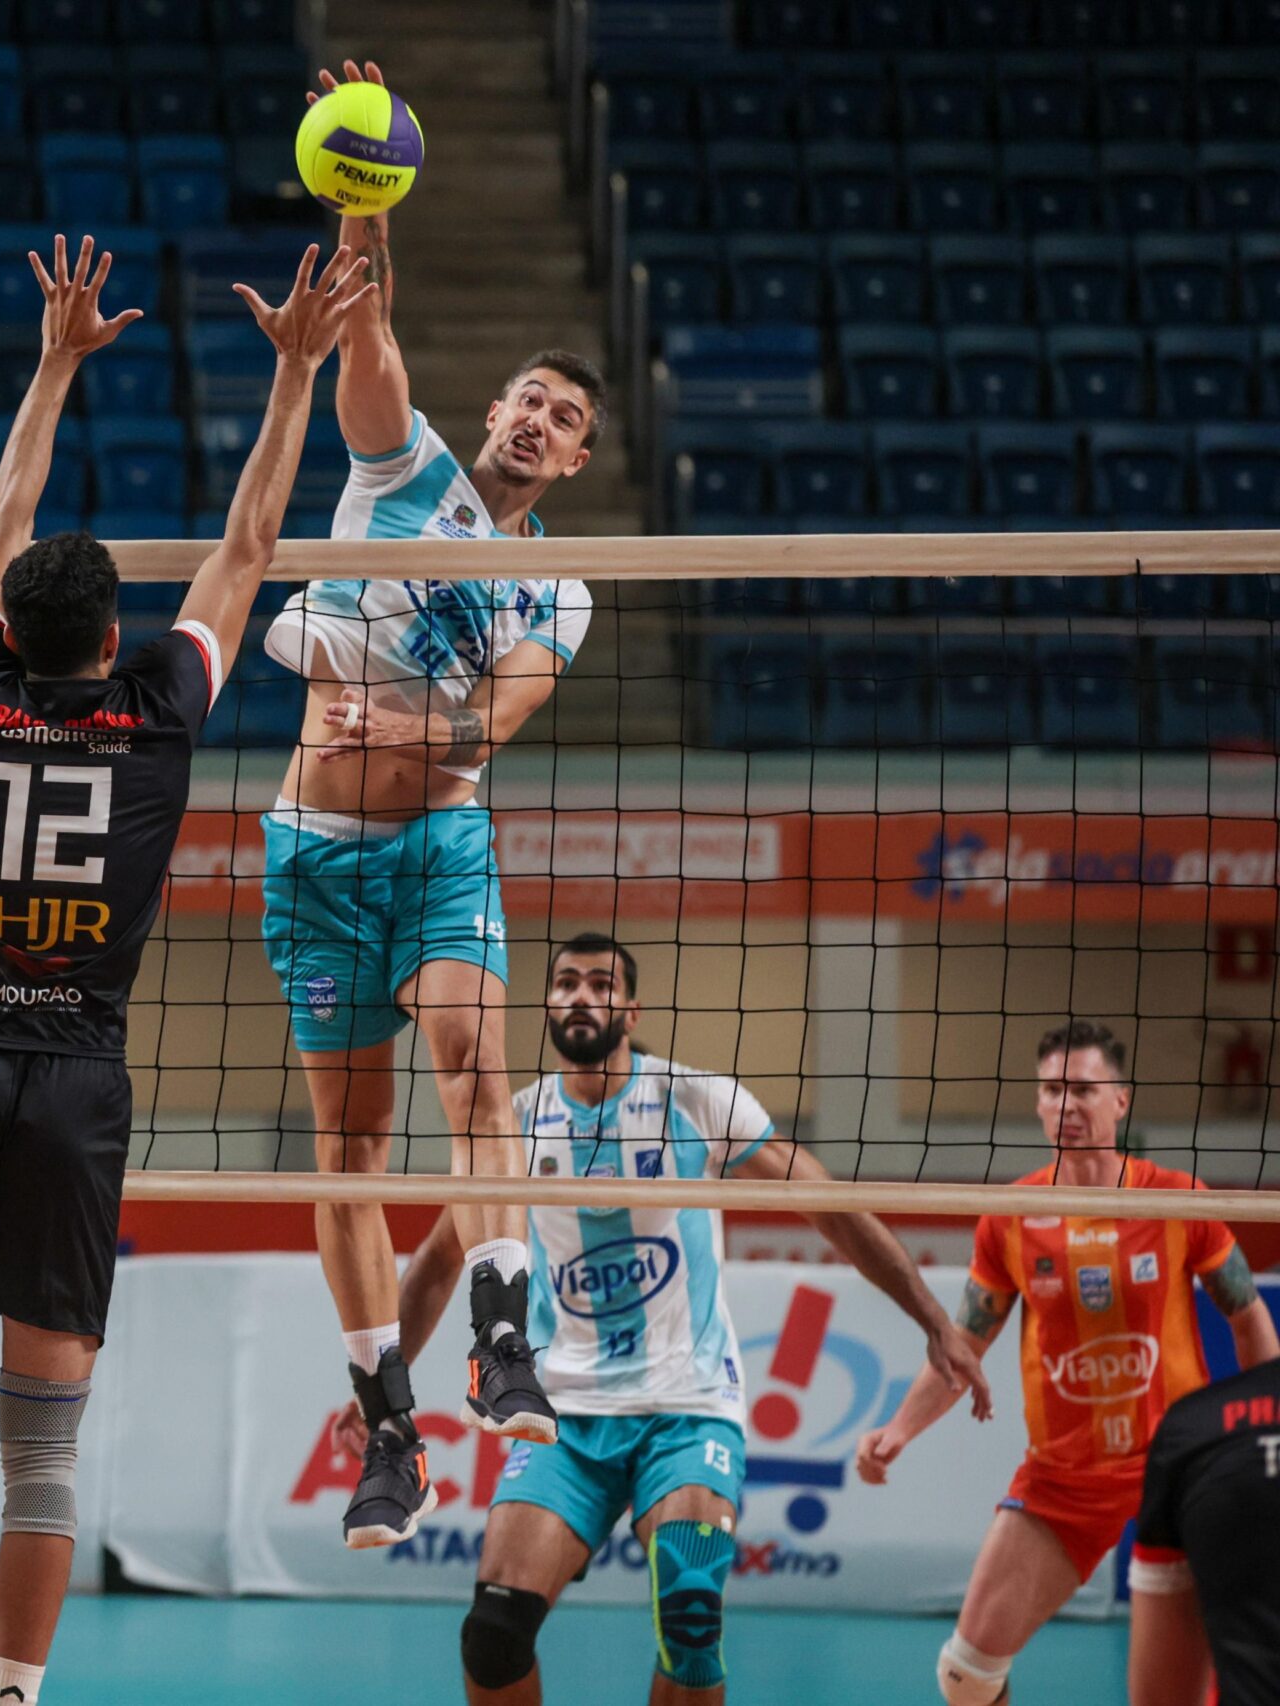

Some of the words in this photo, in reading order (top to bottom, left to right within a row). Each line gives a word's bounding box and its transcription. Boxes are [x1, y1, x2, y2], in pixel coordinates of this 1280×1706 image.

[334, 161, 402, 187] PENALTY
[549, 1249, 658, 1304] Viapol
[607, 1329, 637, 1358] 13
[1042, 1346, 1151, 1390] Viapol
[1101, 1413, 1134, 1455] 10
[704, 1439, 731, 1476] 13
